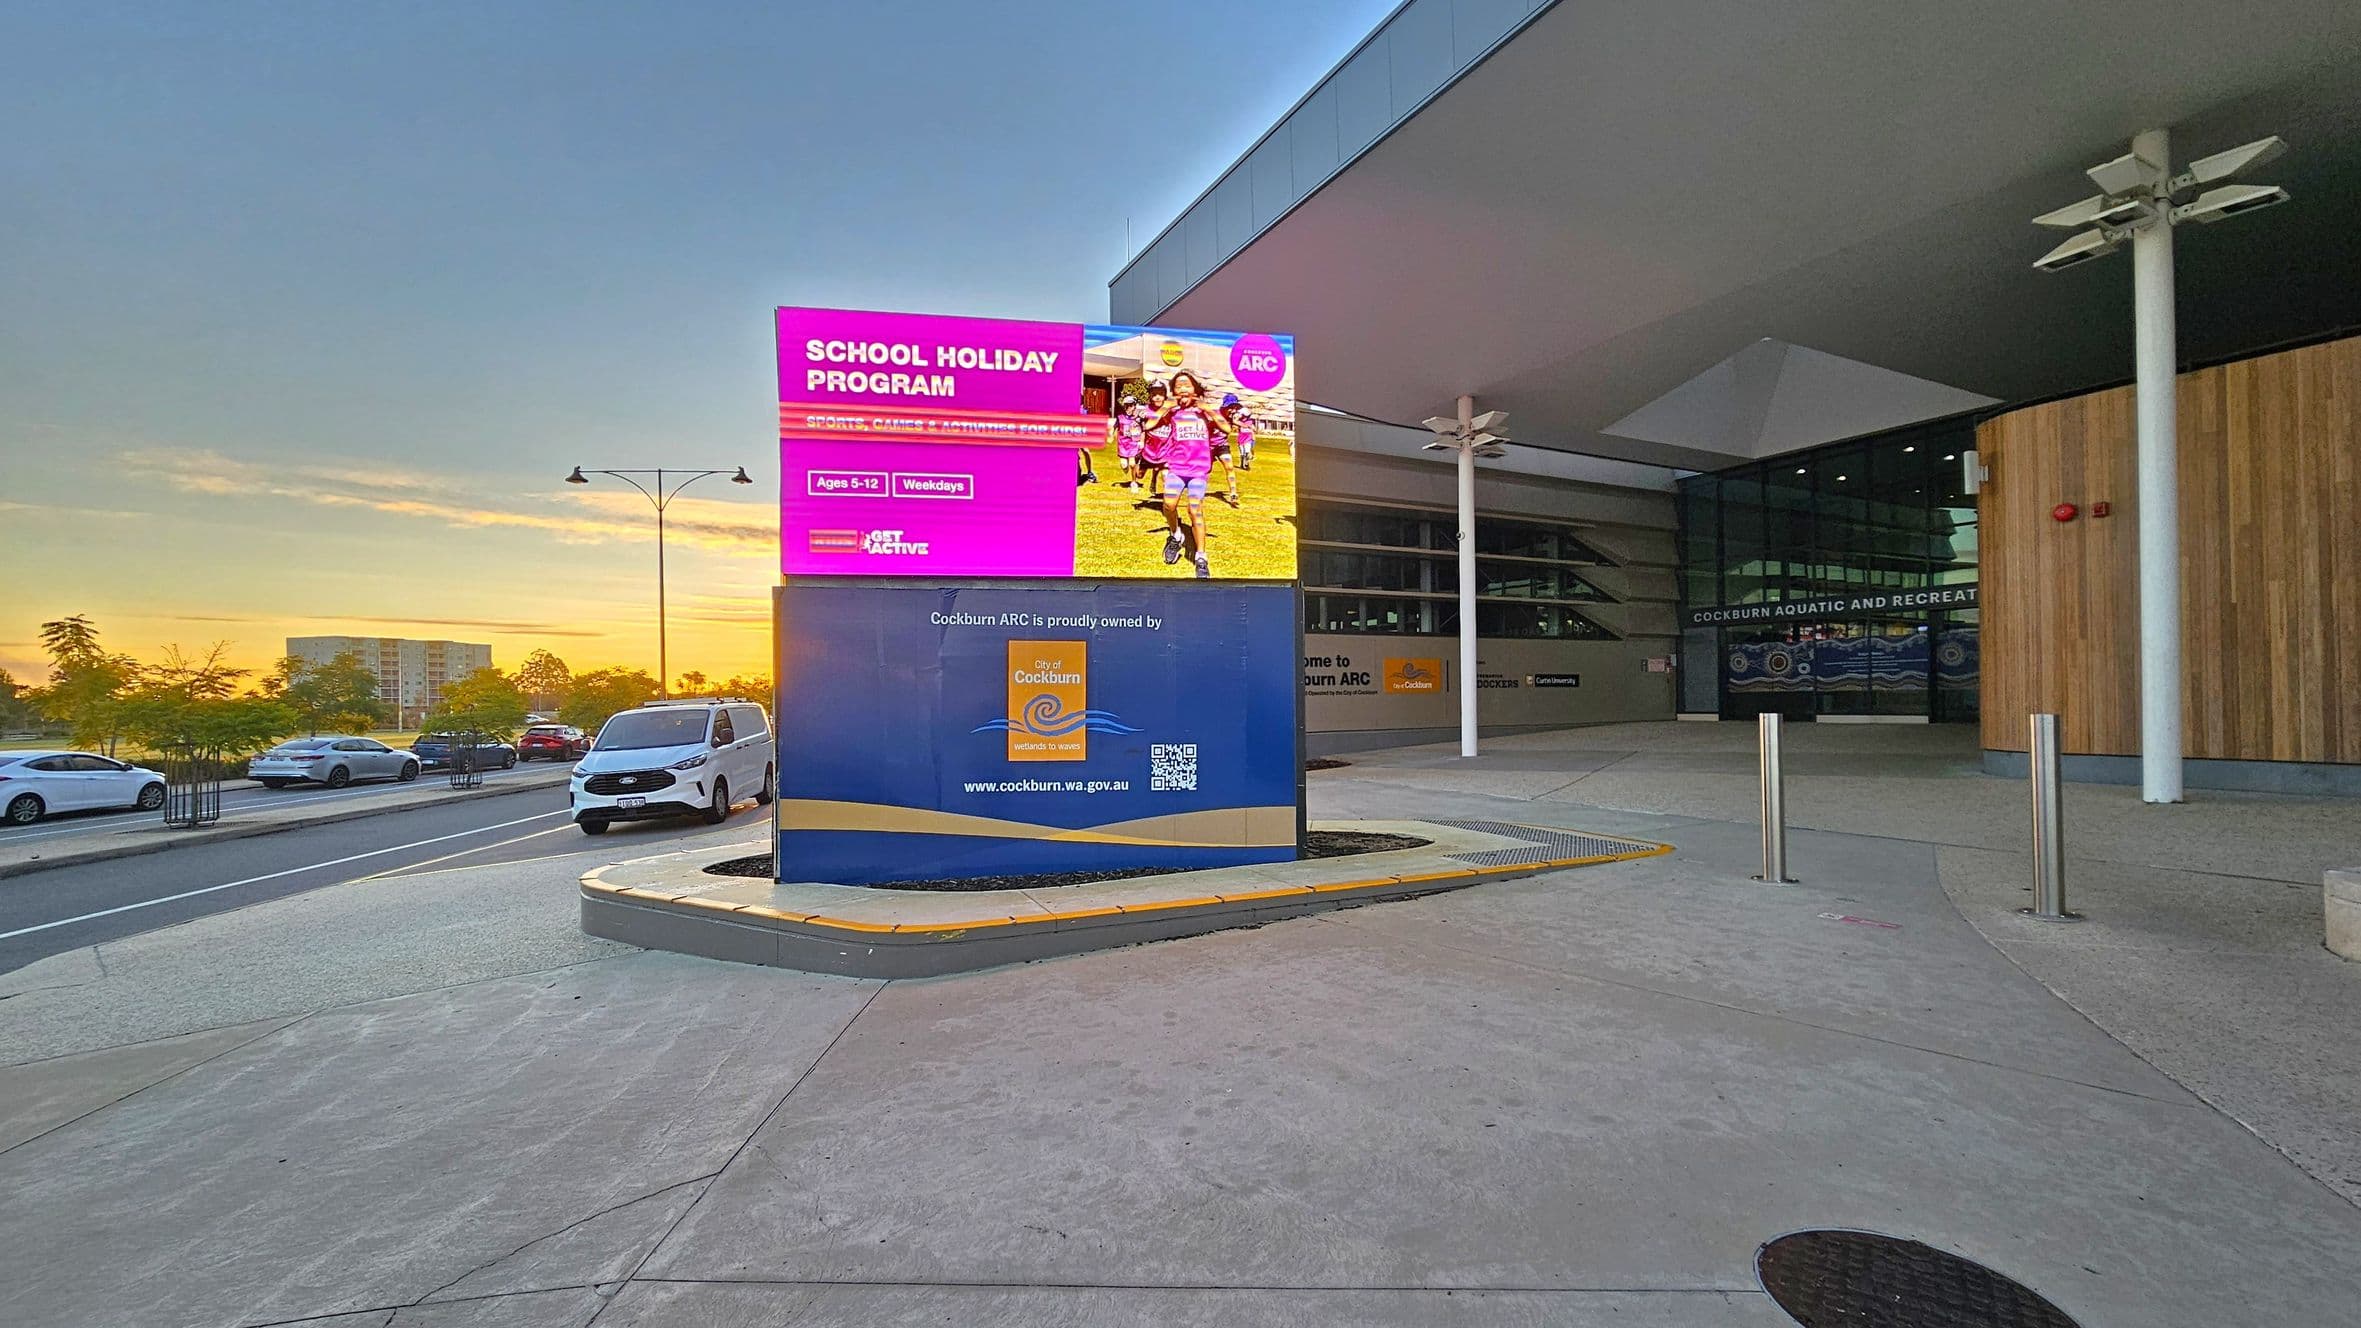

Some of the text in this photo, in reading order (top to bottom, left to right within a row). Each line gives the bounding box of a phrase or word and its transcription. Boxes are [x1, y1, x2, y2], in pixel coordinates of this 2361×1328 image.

[806, 339, 1059, 373] SCHOOL HOLIDAY
[1238, 355, 1279, 372] ARC
[806, 369, 955, 397] PROGRAM
[806, 416, 868, 432] SPORTS,
[873, 418, 924, 432] GAMES
[943, 420, 1015, 434] ACTIVITIES
[1020, 423, 1048, 435] FOR
[816, 476, 879, 490] Ages 5-12
[902, 479, 965, 493] Weekdays
[870, 530, 904, 543] GET
[869, 542, 929, 555] ACTIVE
[1693, 588, 1978, 624] COCKBURN AQUATIC AND RECREAT
[930, 612, 1162, 630] Cockburn ARC is proudly owned by
[1034, 660, 1062, 671] City of
[1336, 654, 1350, 667] to
[1014, 670, 1081, 684] Cockburn
[1340, 672, 1370, 686] ARC
[1477, 680, 1519, 689] DOCKERS
[1014, 741, 1081, 751] wetlands to waves
[964, 778, 1129, 793] www.cockburn.wa.gov.au
